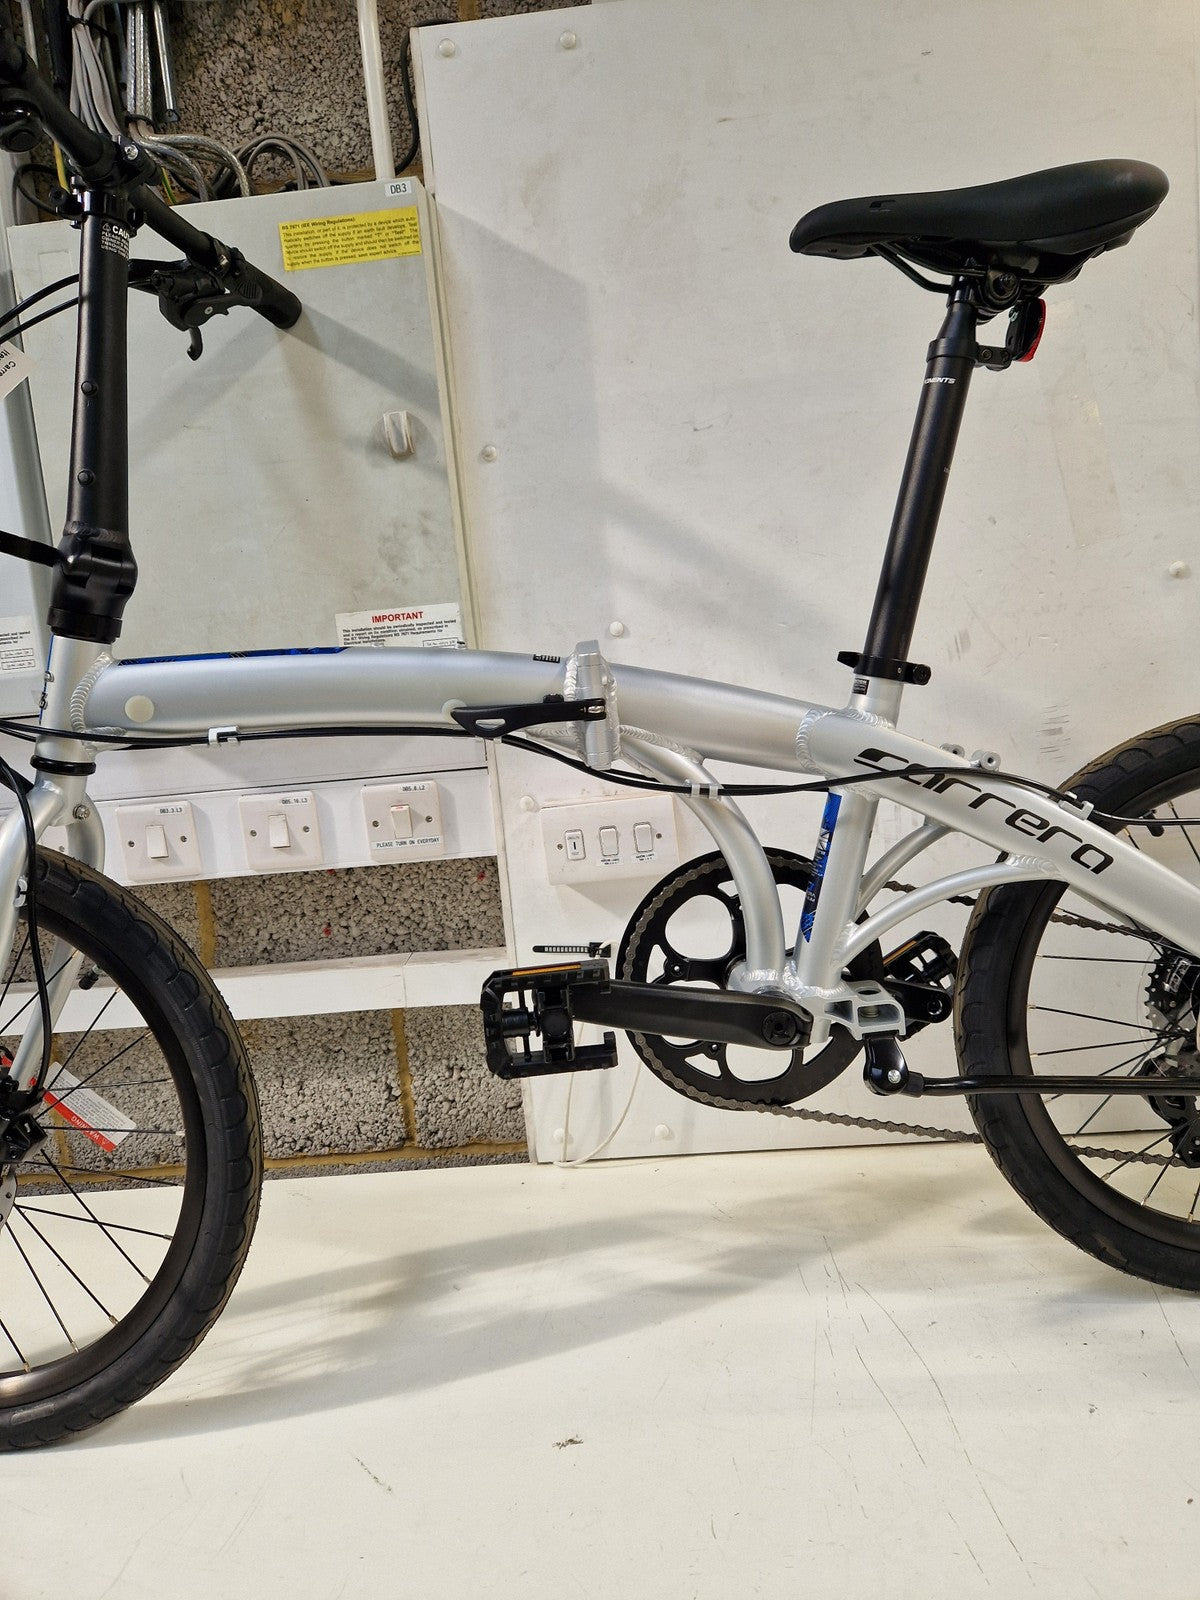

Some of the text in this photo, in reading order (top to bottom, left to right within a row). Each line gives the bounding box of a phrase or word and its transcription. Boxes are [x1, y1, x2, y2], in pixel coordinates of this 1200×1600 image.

[390, 182, 407, 194] DB3
[371, 611, 424, 624] IMPORTANT
[70, 1115, 100, 1140] WANING
